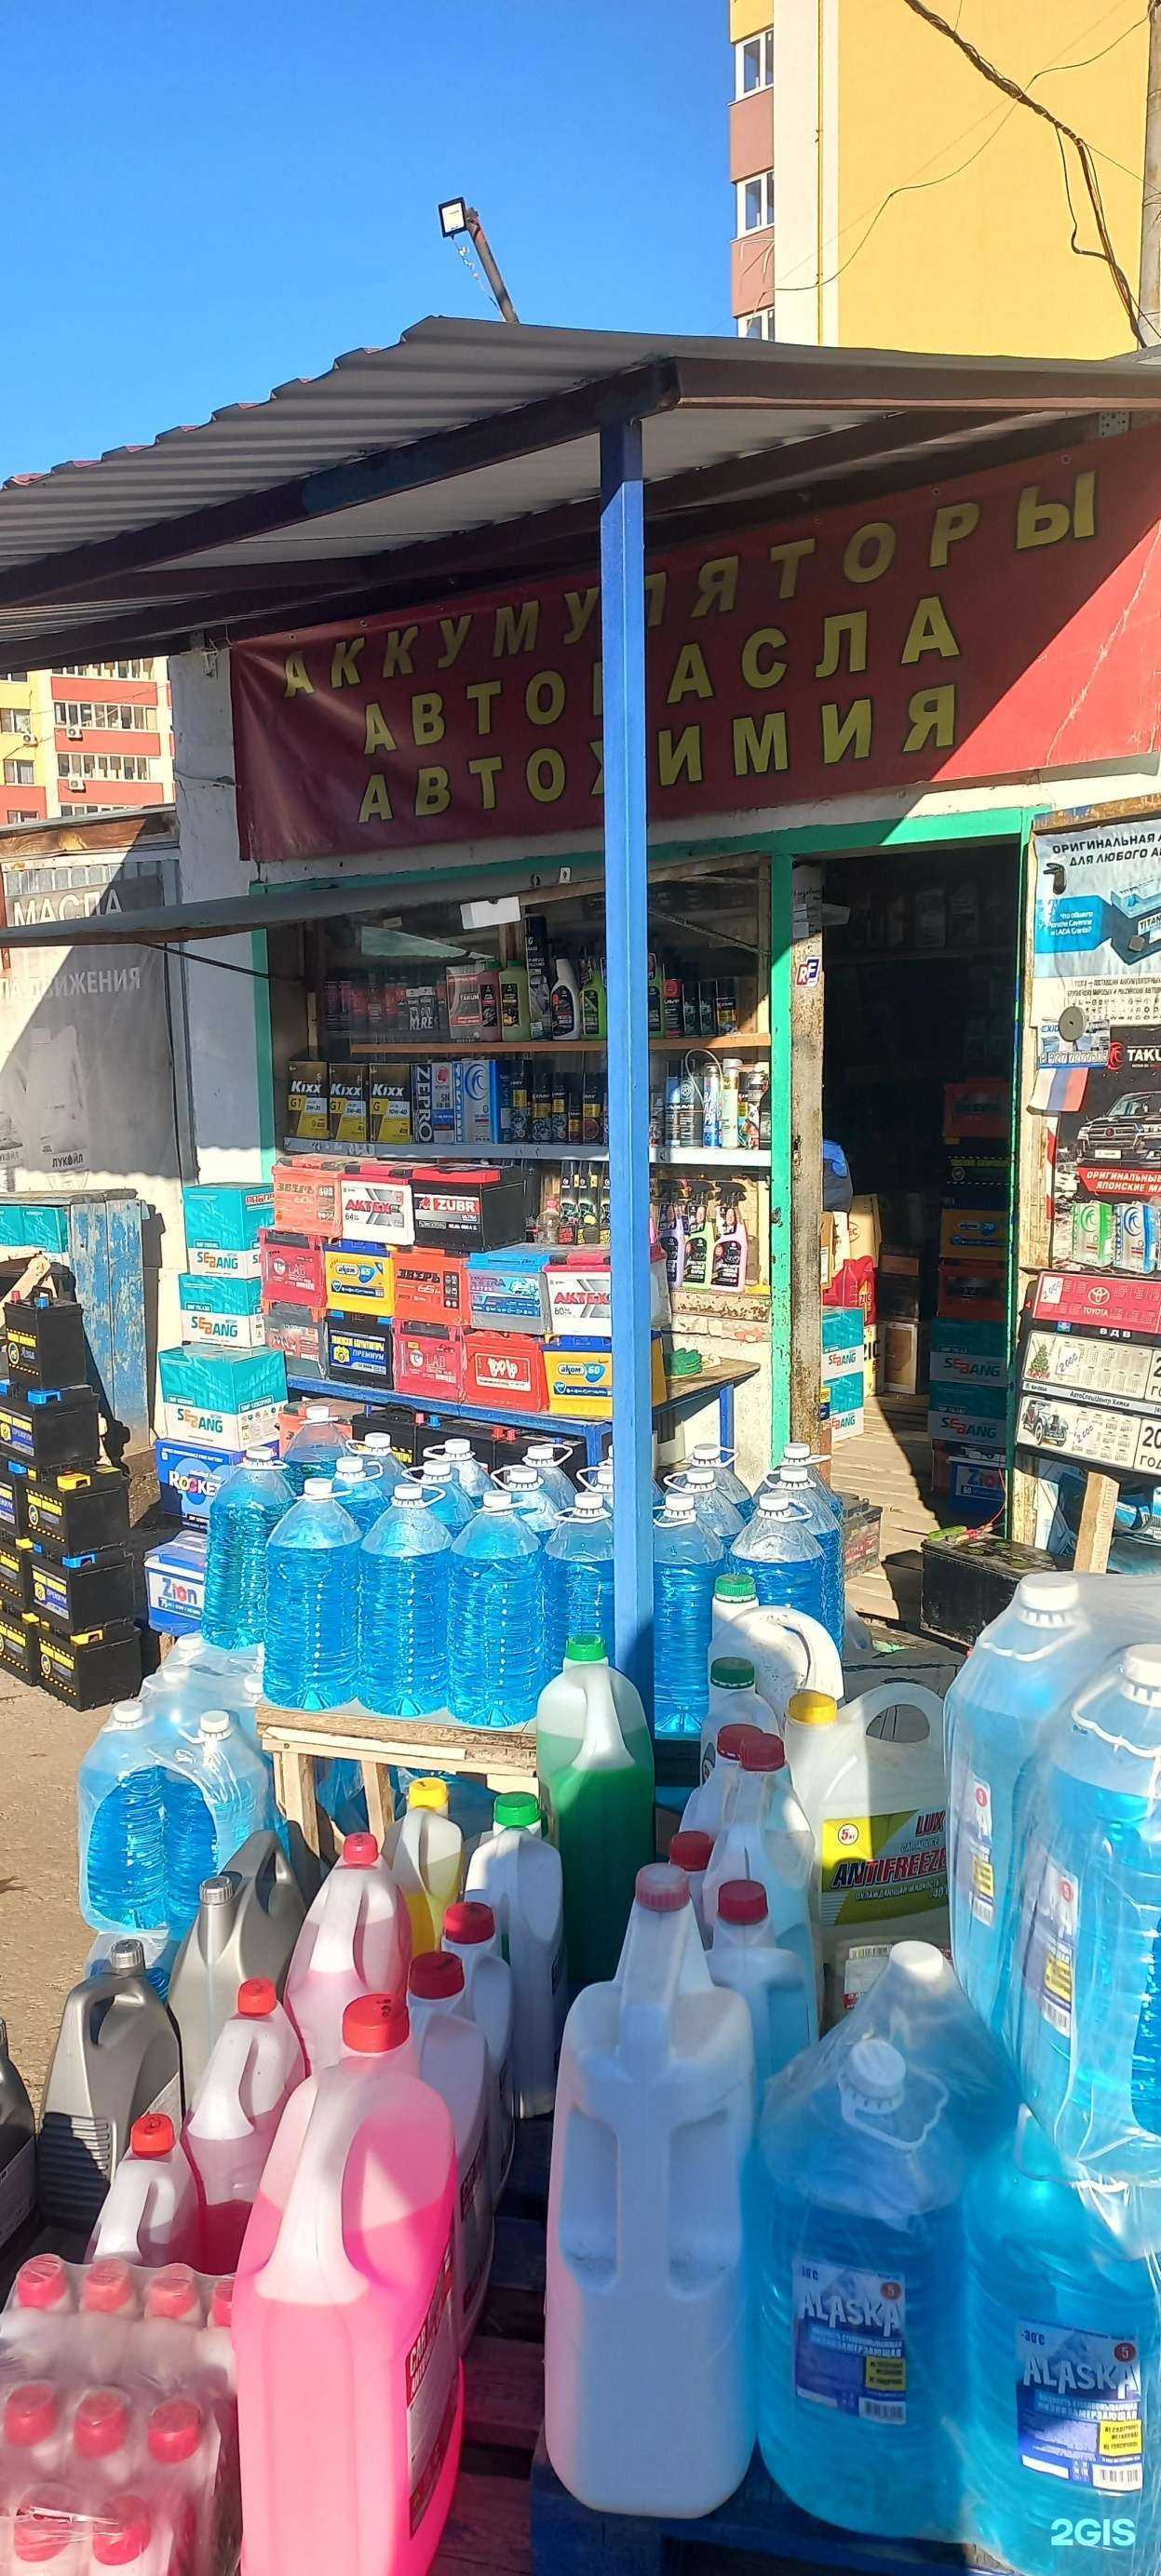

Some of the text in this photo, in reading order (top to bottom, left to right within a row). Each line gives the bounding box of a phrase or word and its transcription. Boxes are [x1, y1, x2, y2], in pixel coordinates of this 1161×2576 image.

[363, 597, 960, 755] АВТОАСЛА
[358, 684, 957, 823] АВТОИМИЯ
[1052, 833, 1155, 854] ОРИГИНАЛЬНАЯ
[1070, 855, 1094, 866] ДЛЯ
[1097, 849, 1148, 864] ЛЮБОГО
[290, 1080, 322, 1093] Kixx
[331, 1083, 362, 1096] Kixx
[372, 1083, 404, 1096] Kixx
[290, 1098, 302, 1107] G1
[331, 1101, 342, 1109] G1
[372, 1102, 380, 1111] G
[416, 1064, 432, 1142] ZEPRO
[52, 1153, 84, 1168] ЛУКОЙЛ
[1096, 1180, 1145, 1191] ЯПОНСКИЕ
[437, 1199, 476, 1212] ZUBR
[196, 1251, 238, 1269] SEBANG
[858, 1293, 872, 1304] ZIC
[1082, 1306, 1109, 1317] TOYOTA
[191, 1315, 237, 1337] SEBANG
[426, 1354, 446, 1368] LAB
[828, 1351, 857, 1367] SEBANG
[943, 1357, 1001, 1377] SEBANG
[560, 1366, 601, 1375] аком 60
[177, 1408, 223, 1433] SEBANG
[940, 1416, 997, 1439] SEBANG
[162, 1576, 197, 1604] Zion
[915, 1810, 946, 1837] LUX
[830, 1846, 946, 1889] ANTIFREEZE
[887, 2285, 895, 2297] 5
[803, 2292, 901, 2337] ALASKA
[1121, 2346, 1128, 2359] 5
[1023, 2357, 1141, 2400] ALASKA
